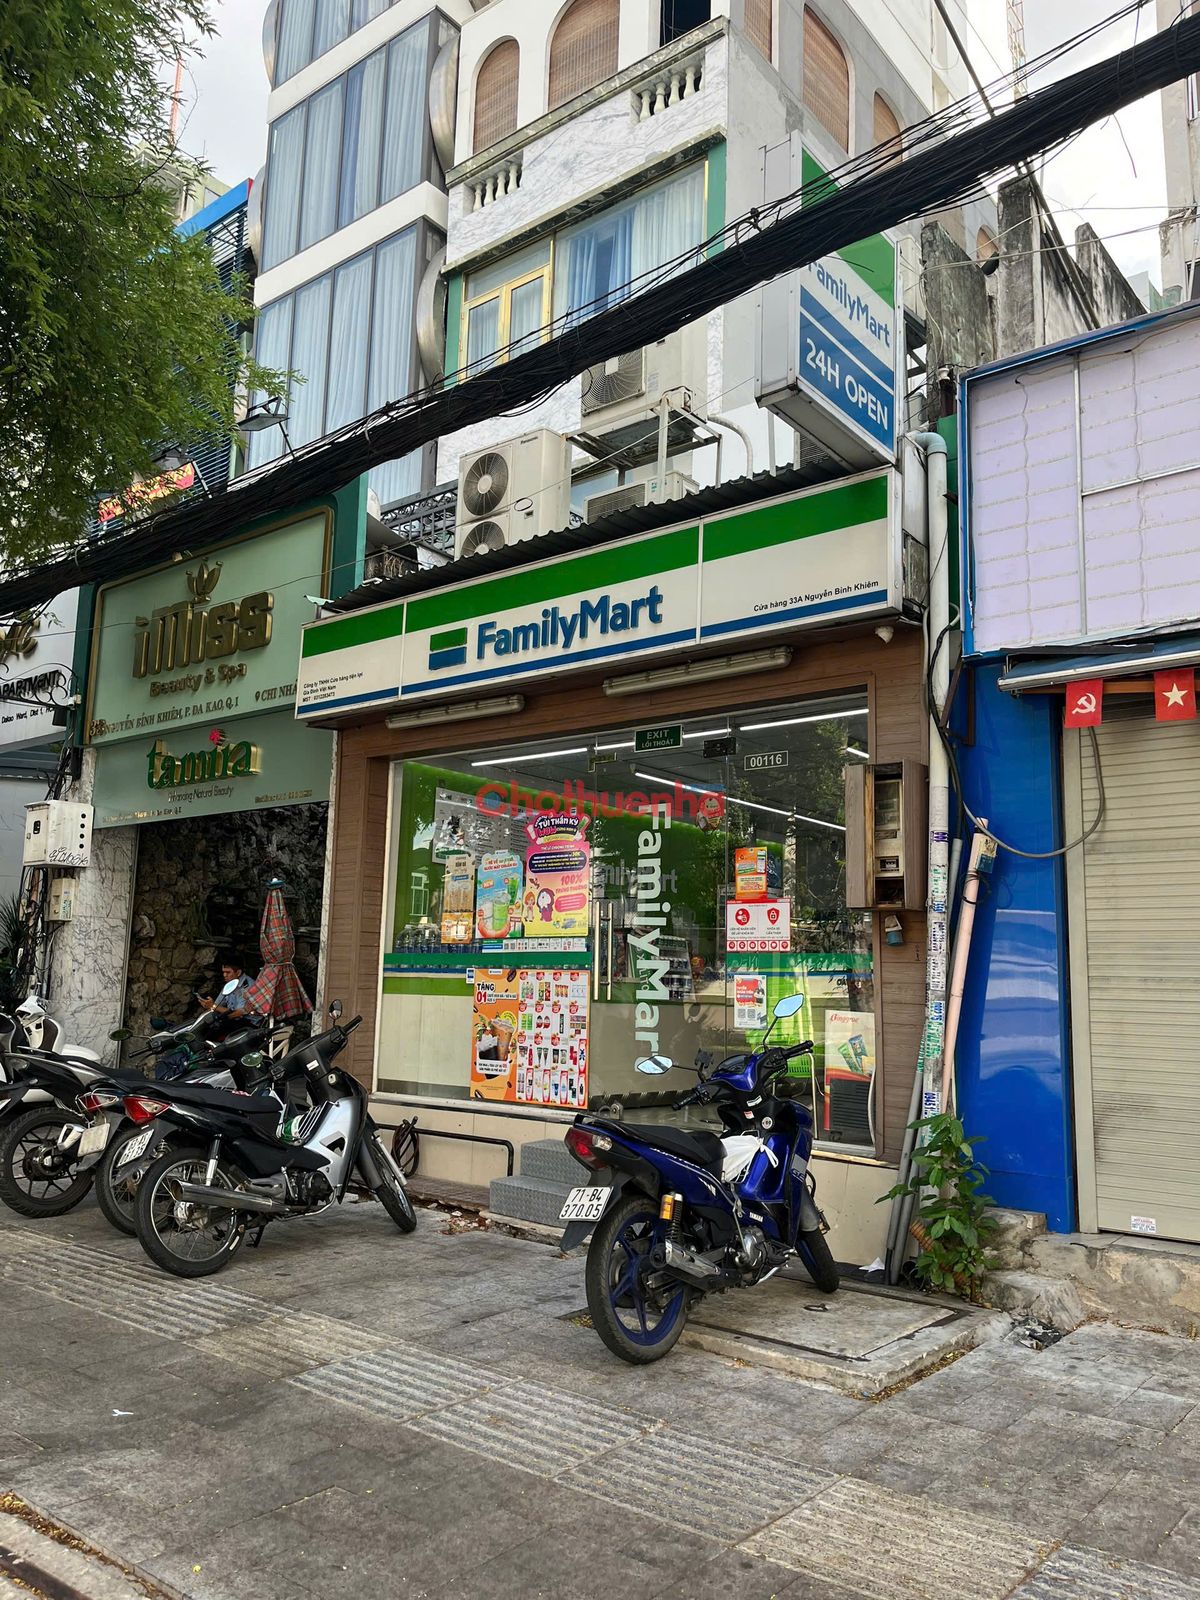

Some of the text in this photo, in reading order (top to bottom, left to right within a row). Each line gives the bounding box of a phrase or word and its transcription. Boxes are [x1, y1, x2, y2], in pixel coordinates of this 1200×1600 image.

[806, 338, 889, 431] 24H OPEN
[789, 596, 803, 605] 33A
[477, 585, 663, 660] FamilyMart
[150, 663, 247, 697] Beauty & Spa
[261, 687, 278, 701] CHI
[647, 729, 669, 740] EXIT
[146, 739, 262, 790] tamira
[750, 754, 782, 768] 00116
[560, 874, 583, 886] 100%
[477, 991, 487, 1003] 01
[561, 1203, 603, 1218] 370.05
